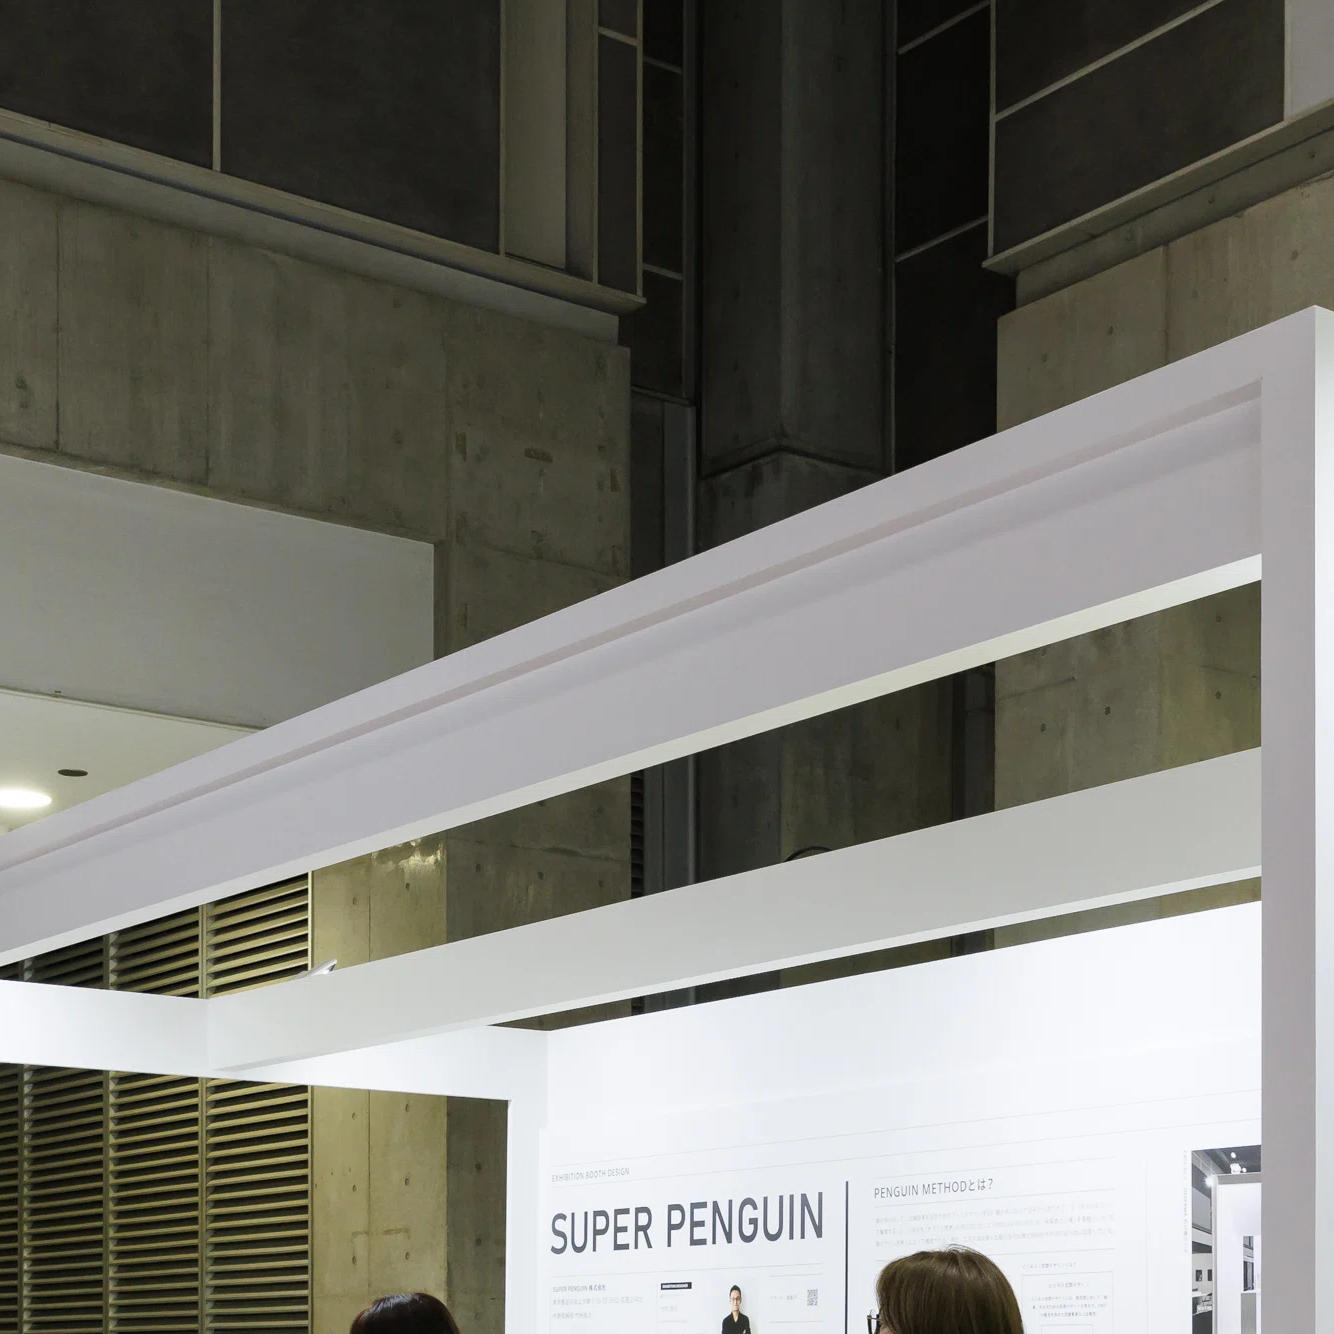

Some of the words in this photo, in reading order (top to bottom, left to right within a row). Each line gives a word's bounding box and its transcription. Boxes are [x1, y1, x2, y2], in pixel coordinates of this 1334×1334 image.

[551, 1172, 584, 1183] EXHIBITION
[585, 1169, 607, 1180] BOOTH
[607, 1167, 630, 1177] DESIGN
[874, 1184, 919, 1199] PENGUIN
[550, 1205, 653, 1255] SUPER
[667, 1191, 823, 1248] PENGUIN
